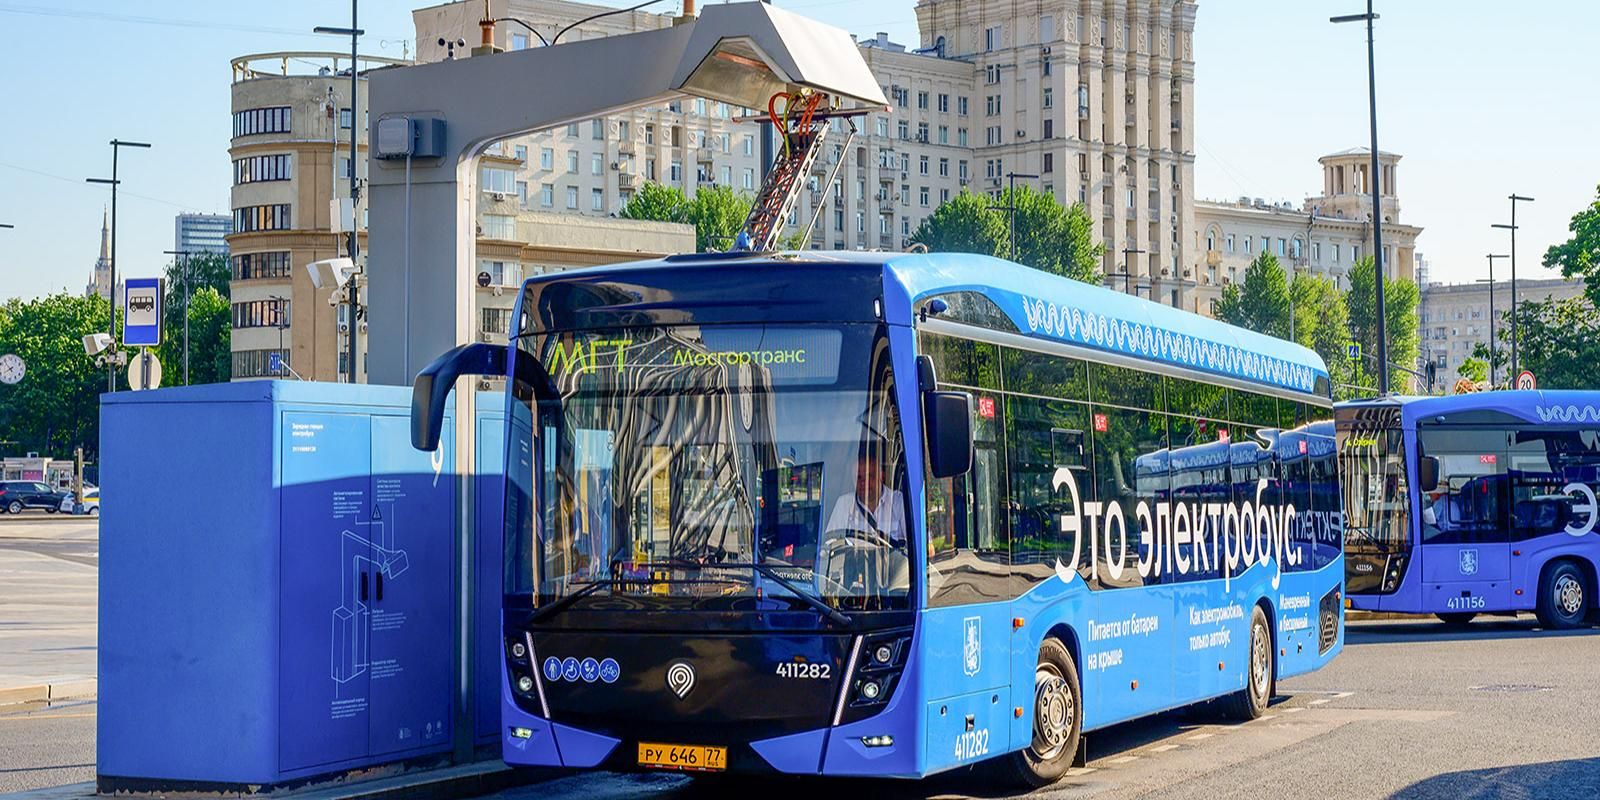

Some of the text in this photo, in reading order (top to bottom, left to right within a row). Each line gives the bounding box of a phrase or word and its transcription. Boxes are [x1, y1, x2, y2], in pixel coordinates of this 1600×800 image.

[548, 339, 633, 375] МГТ
[673, 348, 806, 367] Мосгортранс
[1520, 380, 1532, 390] 20
[1052, 468, 1302, 593] Это электробус.
[1447, 597, 1485, 609] 411156
[1189, 607, 1201, 625] Как
[1088, 613, 1159, 642] Питается от батареи
[1189, 625, 1231, 651] только автобус
[776, 662, 831, 679] 411282
[1088, 648, 1123, 672] на крыше
[954, 728, 989, 761] 411282
[669, 747, 697, 764] 646
[706, 749, 721, 761] 77
